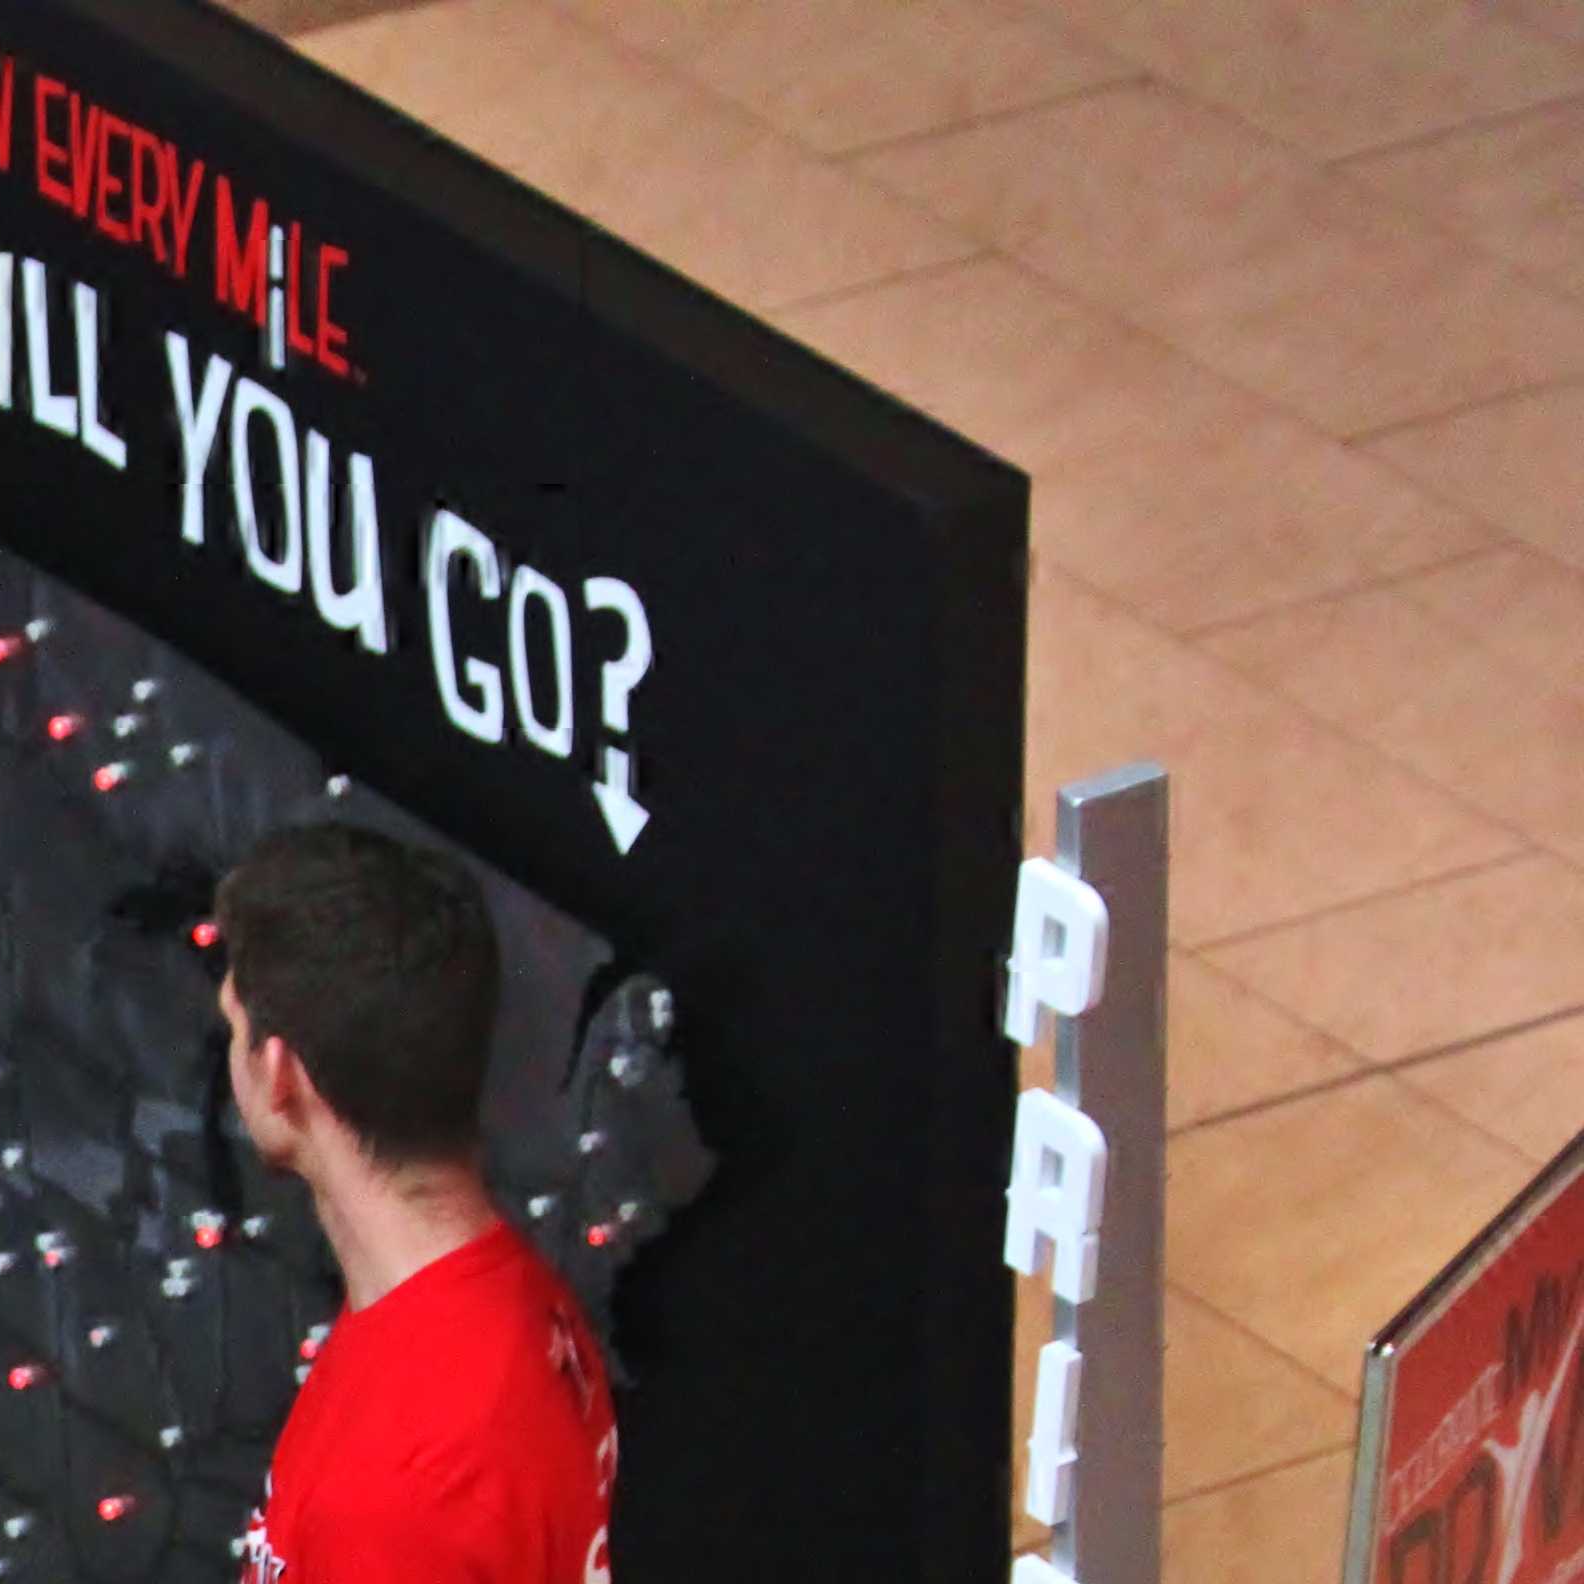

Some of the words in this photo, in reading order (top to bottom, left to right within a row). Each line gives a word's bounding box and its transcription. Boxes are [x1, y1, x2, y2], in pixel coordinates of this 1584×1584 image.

[35, 74, 205, 278] EVERY
[165, 329, 389, 655] YOU
[427, 507, 653, 858] GO?
